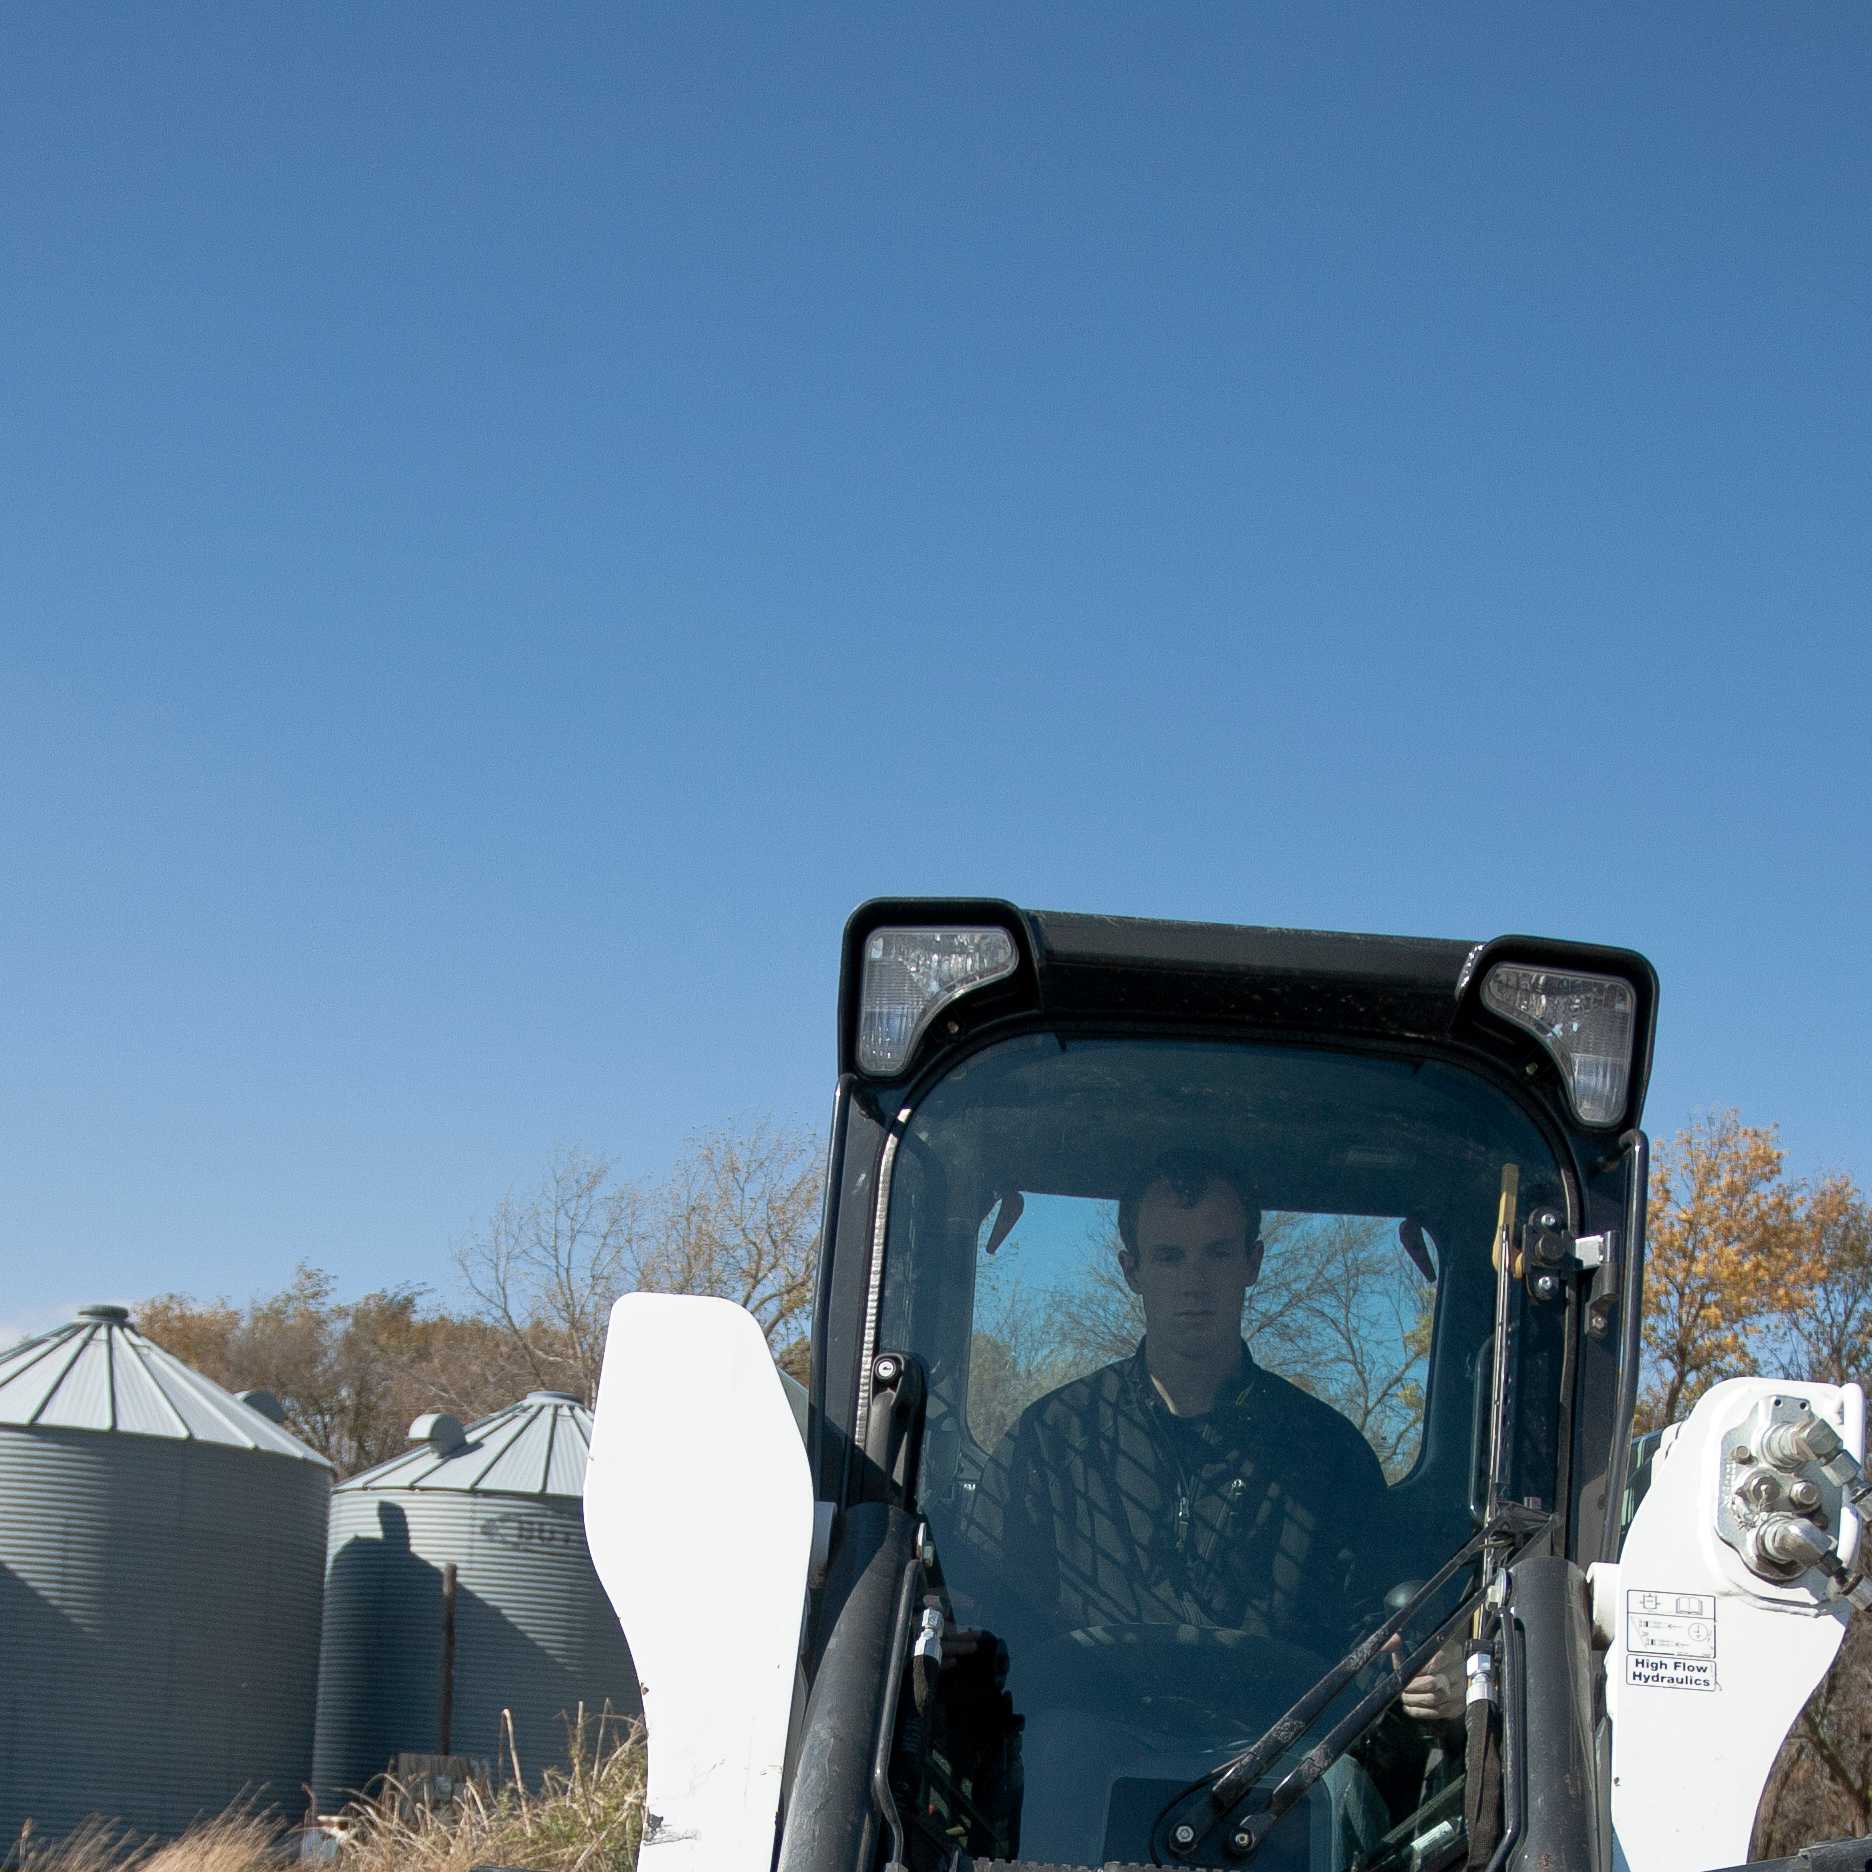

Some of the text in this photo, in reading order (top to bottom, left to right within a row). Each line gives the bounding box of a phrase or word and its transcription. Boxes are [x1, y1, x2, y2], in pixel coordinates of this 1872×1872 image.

[1635, 1658, 1708, 1673] High Flow
[1632, 1671, 1710, 1687] Hydraulics
